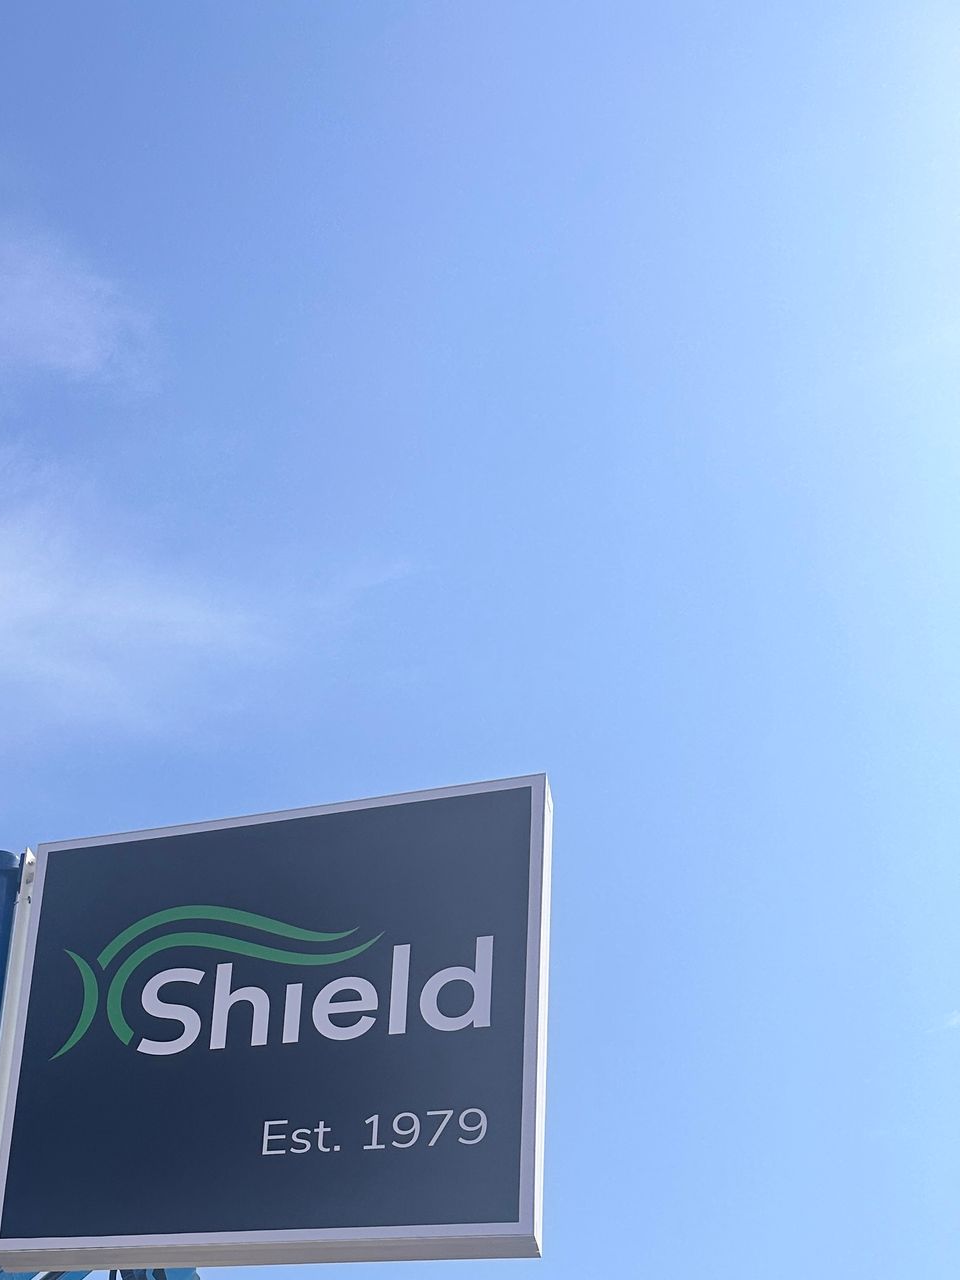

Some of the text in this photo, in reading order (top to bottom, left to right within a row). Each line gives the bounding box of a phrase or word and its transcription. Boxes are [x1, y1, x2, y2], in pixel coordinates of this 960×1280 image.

[136, 935, 494, 1056] Shield
[261, 1108, 488, 1156] Est. 1979
